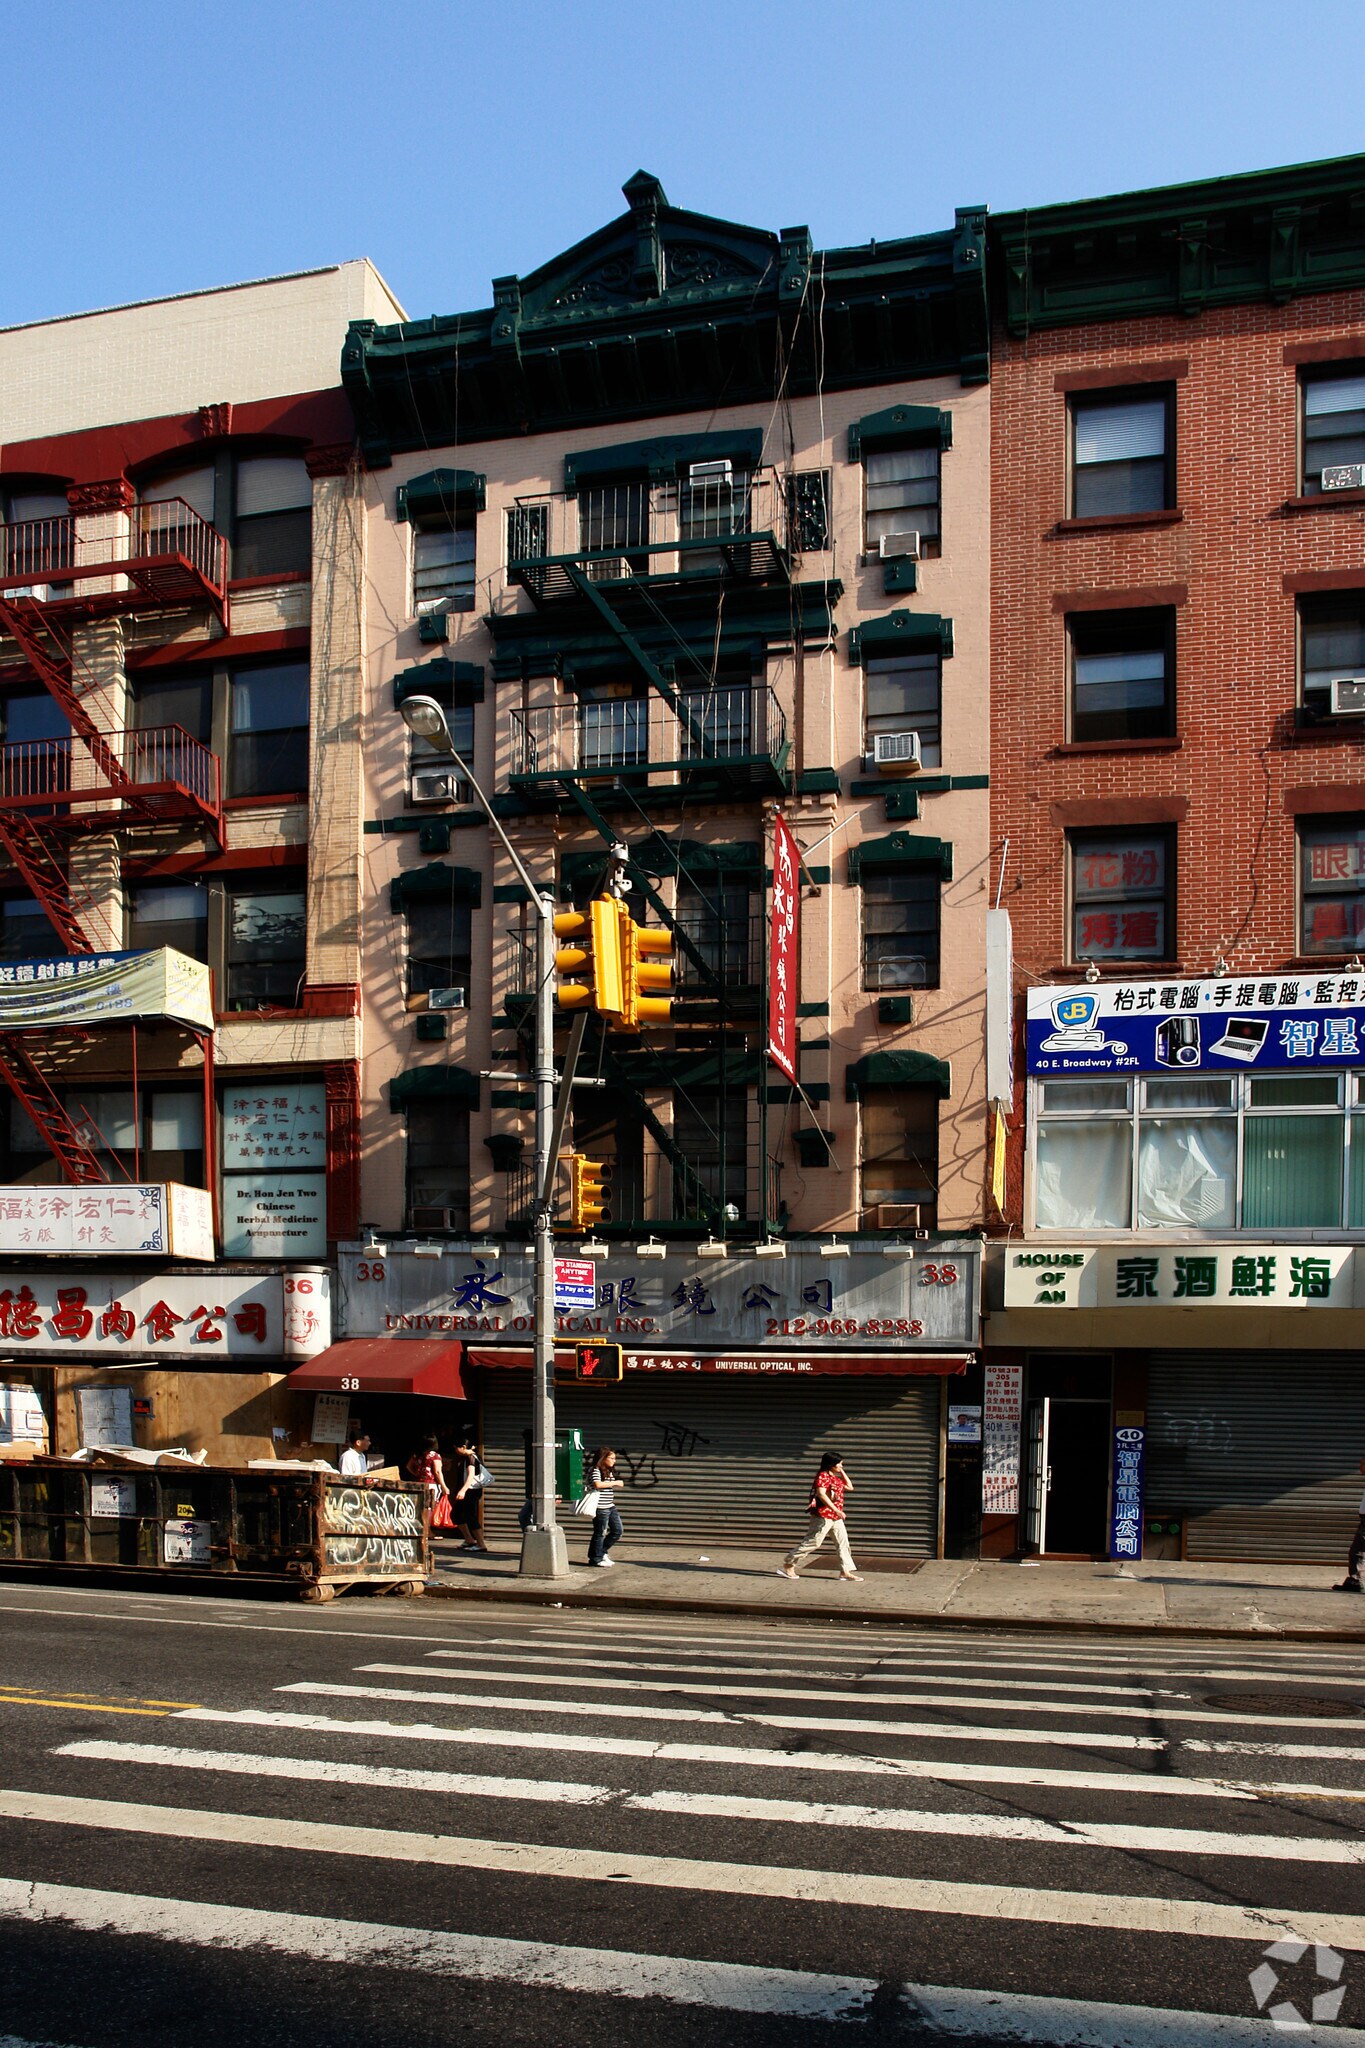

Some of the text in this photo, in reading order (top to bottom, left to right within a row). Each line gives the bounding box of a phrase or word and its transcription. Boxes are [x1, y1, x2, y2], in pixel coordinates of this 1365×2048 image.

[1082, 850, 1160, 889] 花粉
[1063, 1003, 1088, 1019] JB
[1279, 1016, 1365, 1058] 智星
[1051, 1060, 1061, 1068] E.
[1063, 1058, 1112, 1067] Broadway
[1116, 1057, 1140, 1066] #2FL
[237, 1189, 317, 1198] Dr. Hon Jen Two
[256, 1202, 296, 1211] Chinese
[236, 1215, 318, 1224] Herbal Medicine
[245, 1229, 308, 1238] Acupuncture
[1019, 1254, 1085, 1265] HOUSE
[356, 1263, 386, 1281] 38
[921, 1264, 957, 1285] 38
[1041, 1272, 1066, 1283] OF
[285, 1279, 313, 1294] 36
[1039, 1290, 1066, 1302] AN
[385, 1315, 660, 1333] UNIVERSAL OICAL INC.
[766, 1318, 923, 1336] 212-966-8288
[715, 1361, 813, 1372] UNIVERSAL OPTICAL, INC.
[341, 1377, 359, 1390] 38
[1119, 1430, 1140, 1440] 40
[1115, 1450, 1141, 1555] 智星電腦公司
